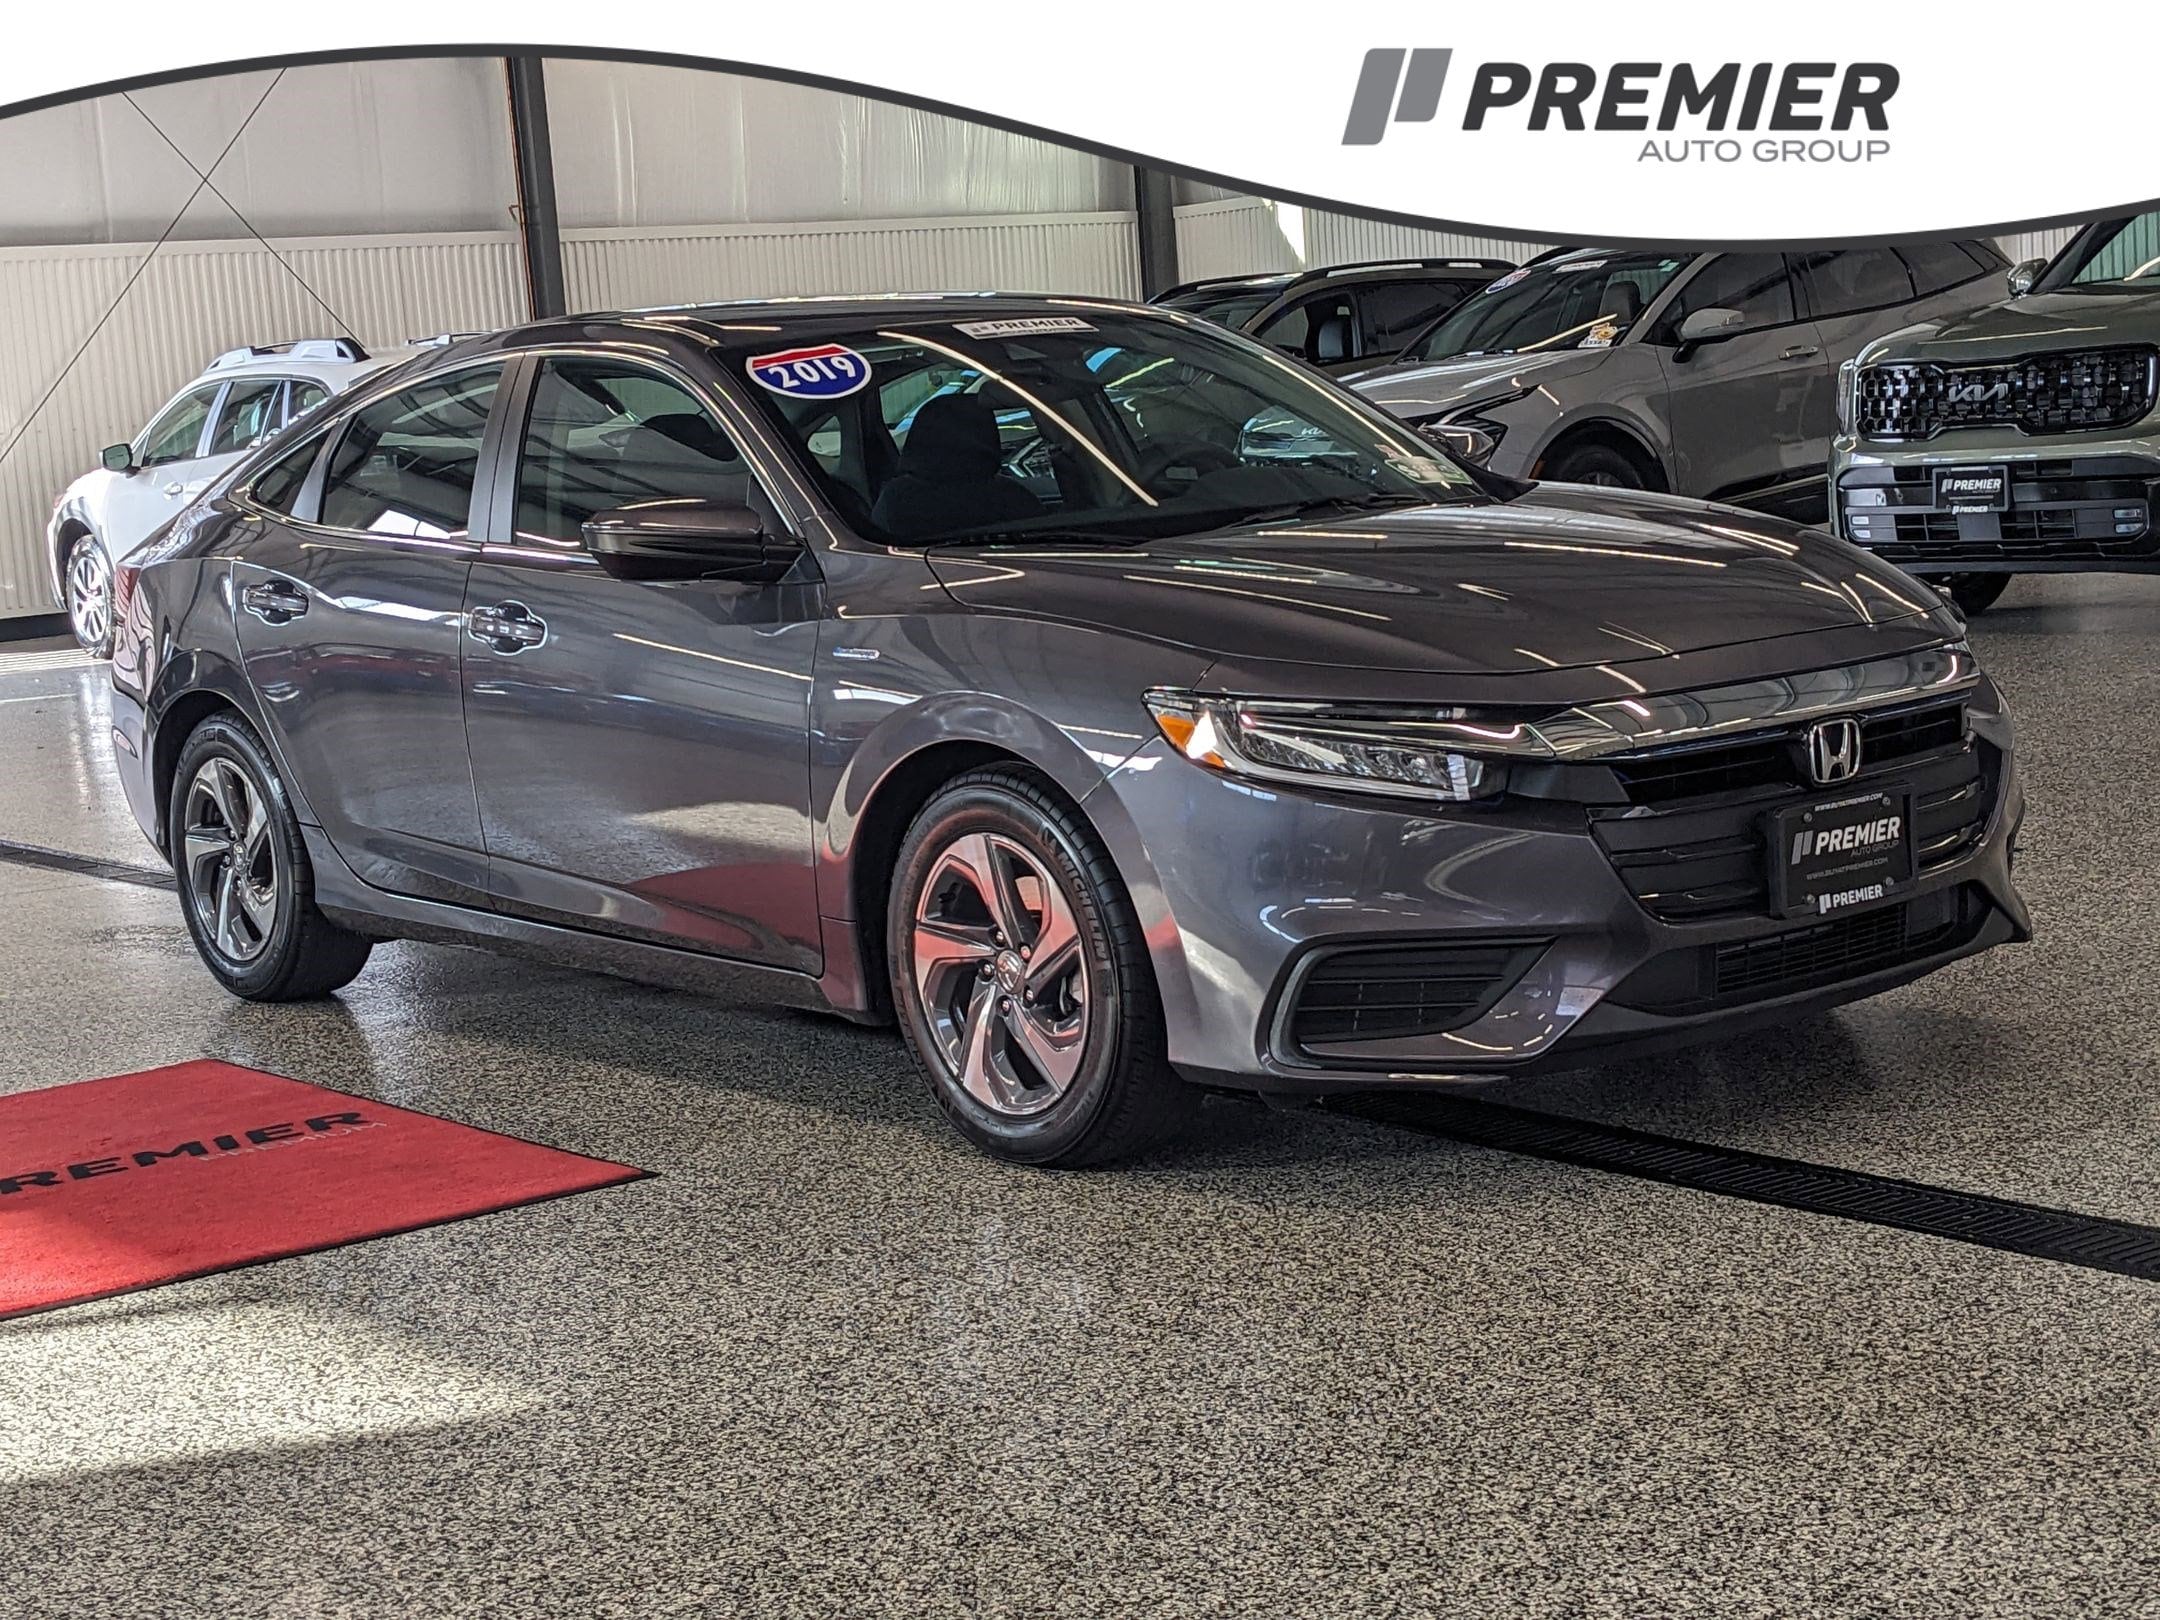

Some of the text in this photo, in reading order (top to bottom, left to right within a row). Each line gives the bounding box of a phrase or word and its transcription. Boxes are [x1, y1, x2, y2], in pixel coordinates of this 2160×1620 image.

[991, 318, 1078, 331] PREMIER
[767, 356, 857, 389] 2019
[1953, 478, 2002, 491] PREMIER
[1815, 816, 1901, 856] PREMIER
[1851, 846, 1871, 857] AUTO
[1058, 852, 1108, 960] MICHELIN
[1832, 884, 1884, 908] PREMIER
